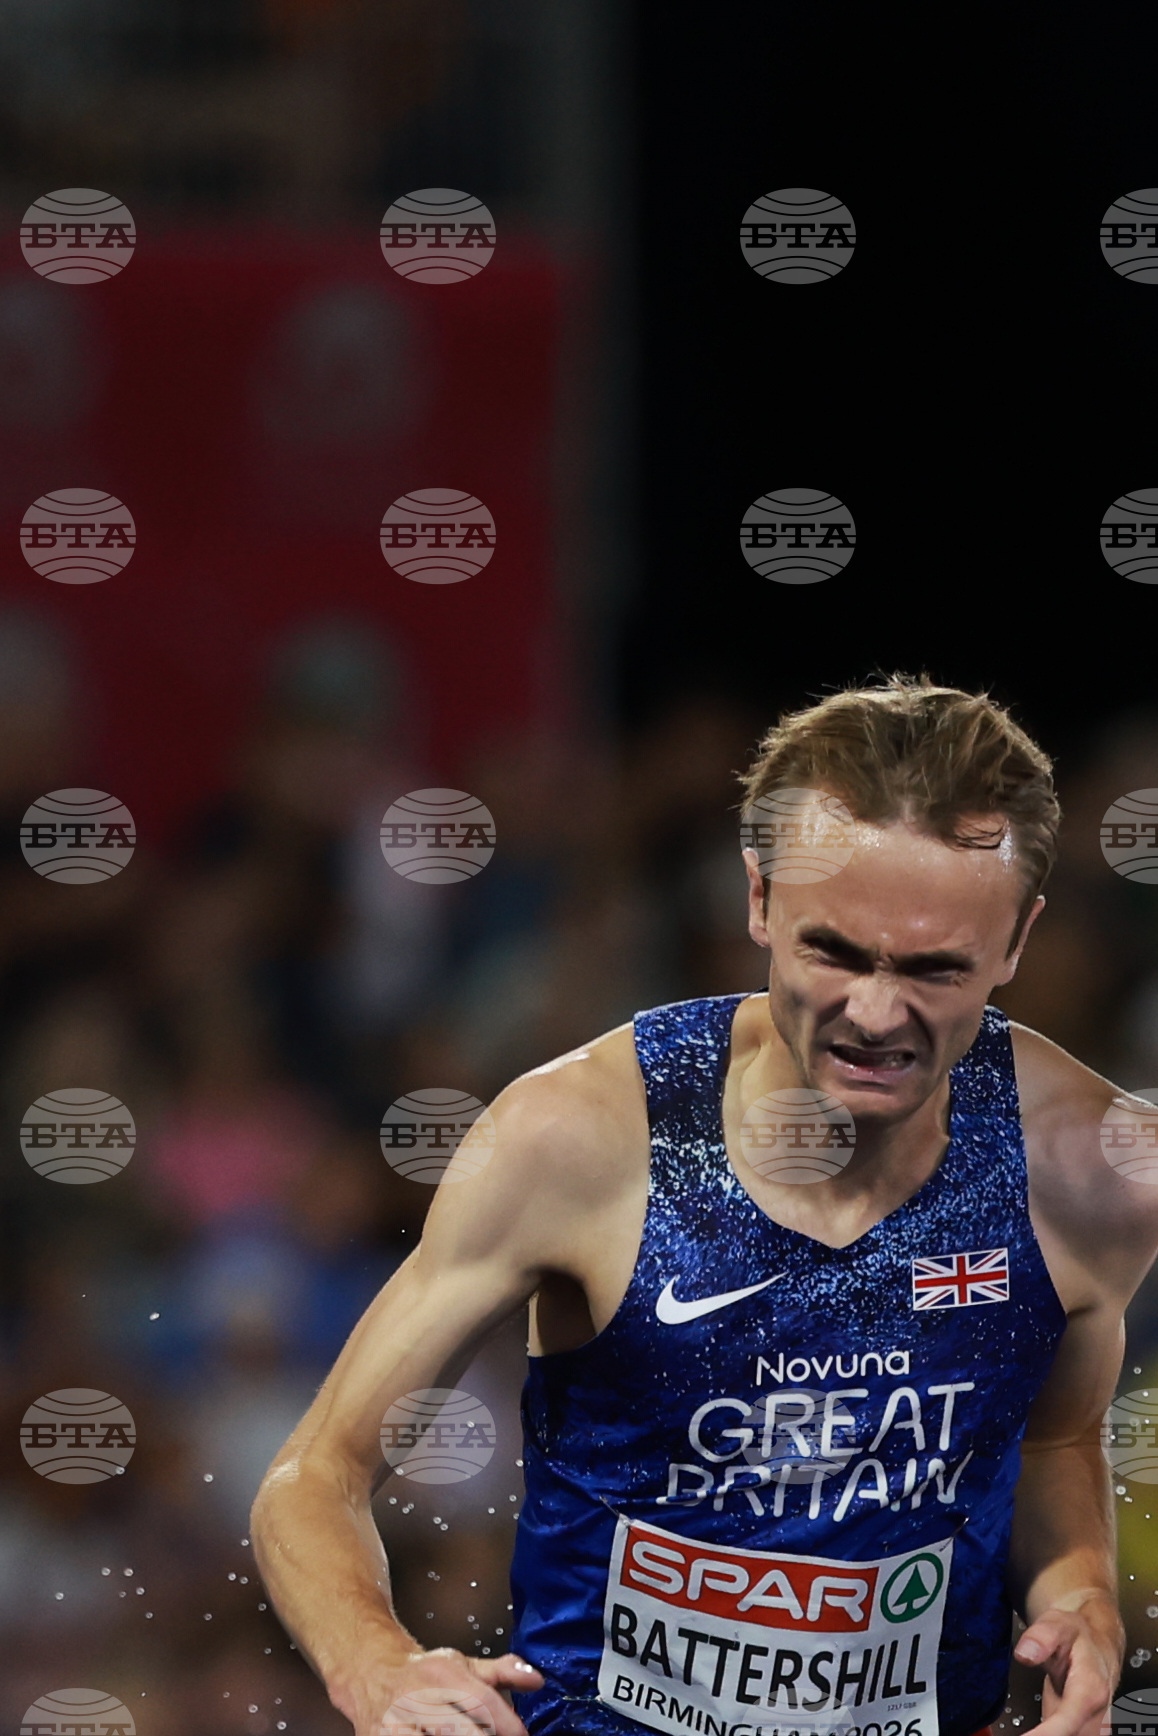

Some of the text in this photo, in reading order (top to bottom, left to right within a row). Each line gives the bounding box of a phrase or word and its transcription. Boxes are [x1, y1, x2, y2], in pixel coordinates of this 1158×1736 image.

[756, 1350, 910, 1386] Novuna
[688, 1382, 975, 1463] GREAT
[656, 1449, 975, 1522] BRITAIN
[628, 1540, 869, 1623] SPAR
[610, 1603, 927, 1712] BATTERSHILL
